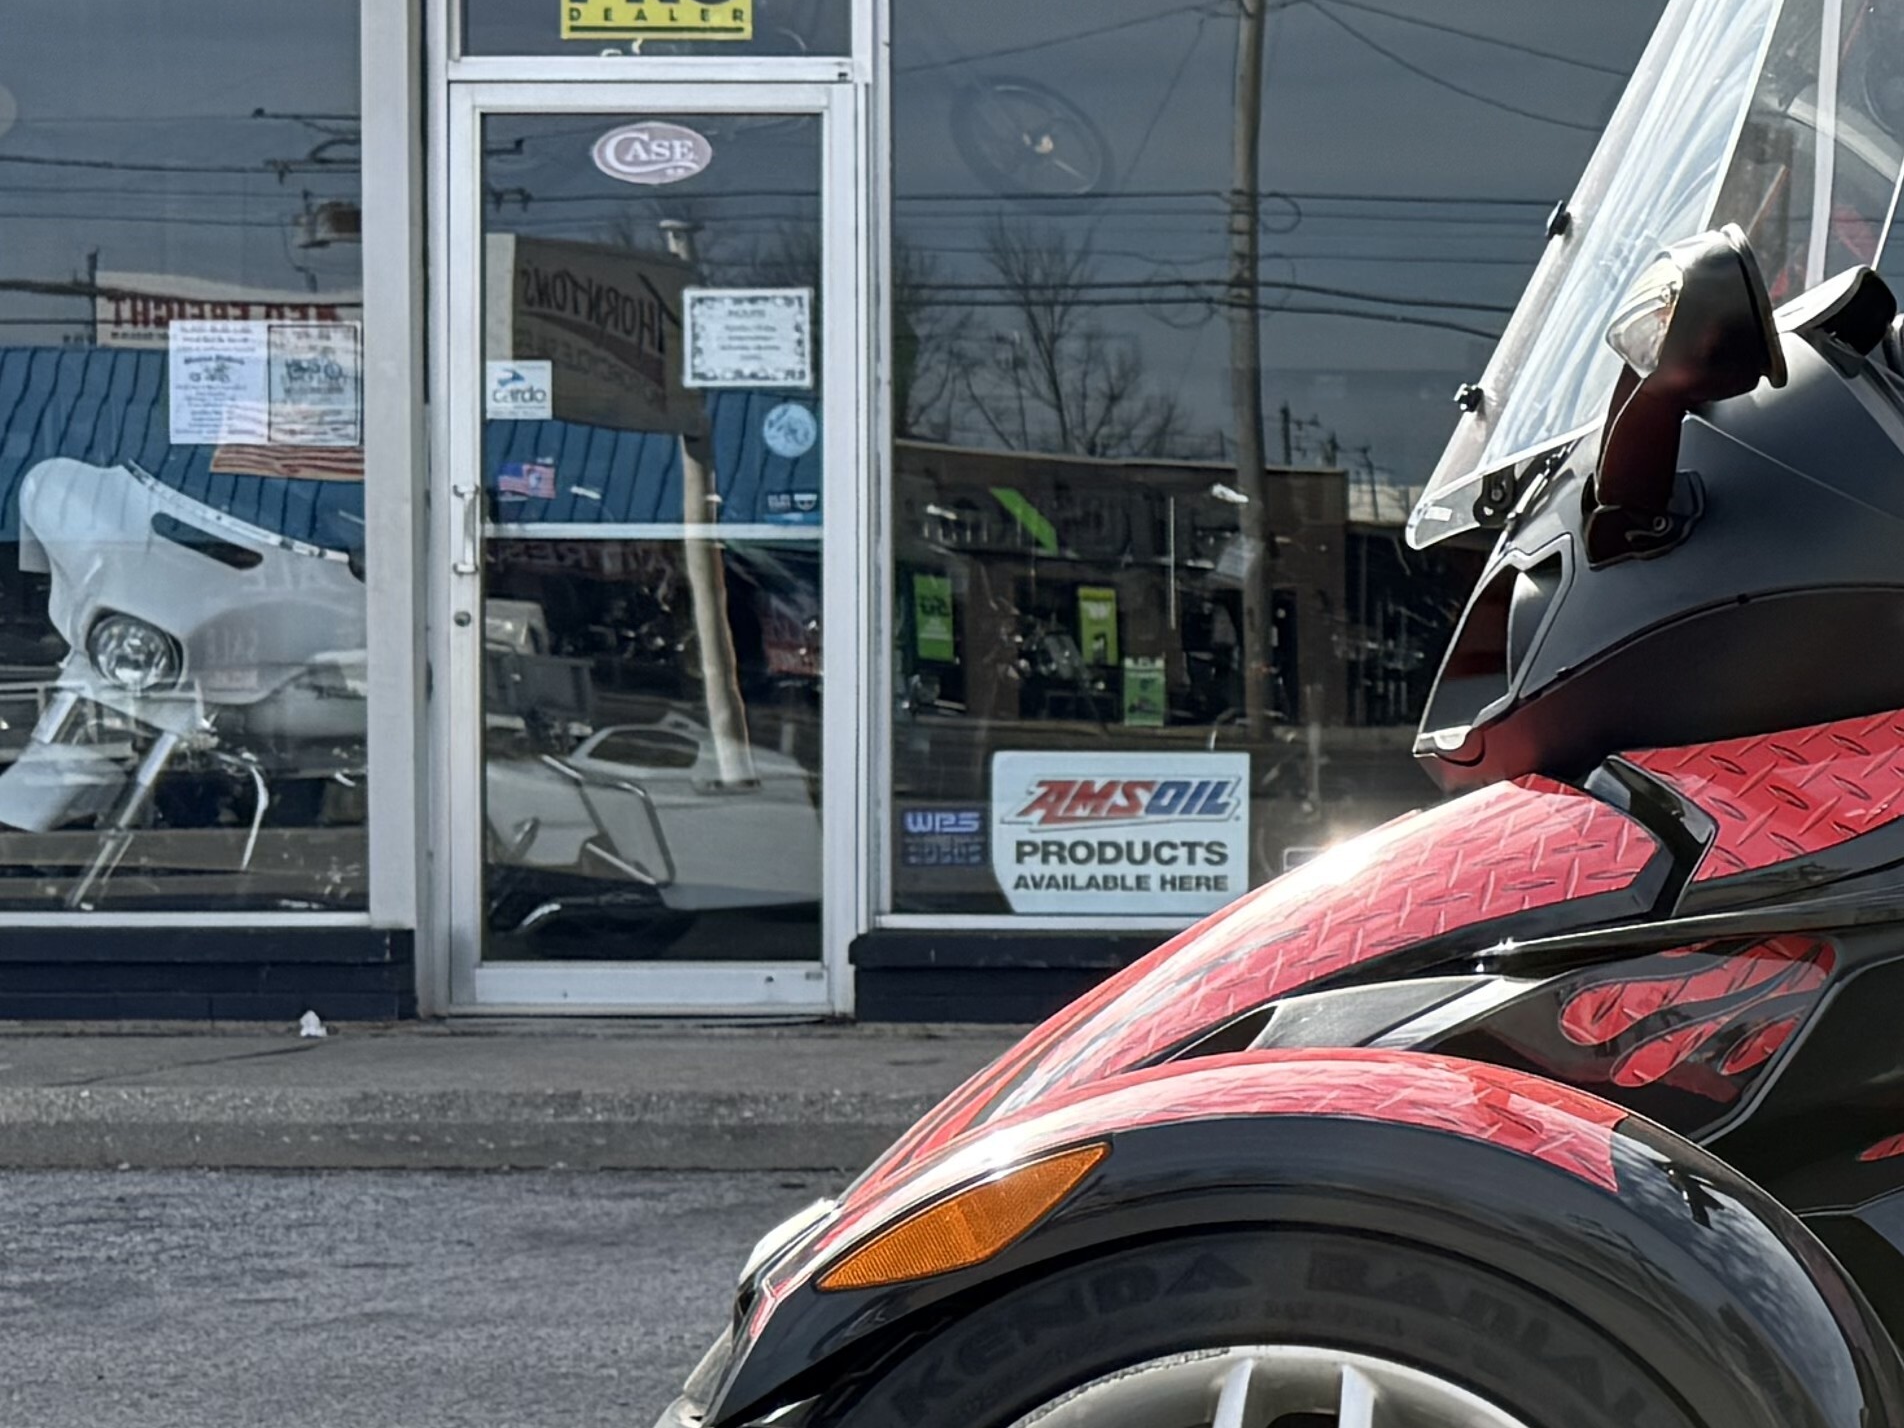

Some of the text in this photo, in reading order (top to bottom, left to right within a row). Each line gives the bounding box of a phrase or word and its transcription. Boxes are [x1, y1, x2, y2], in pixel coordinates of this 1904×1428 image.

[569, 8, 744, 21] DEALER
[1016, 779, 1232, 824] AMSOIL
[1015, 840, 1228, 866] PRODUCTS
[1014, 875, 1228, 891] AVAILABLE HERE
